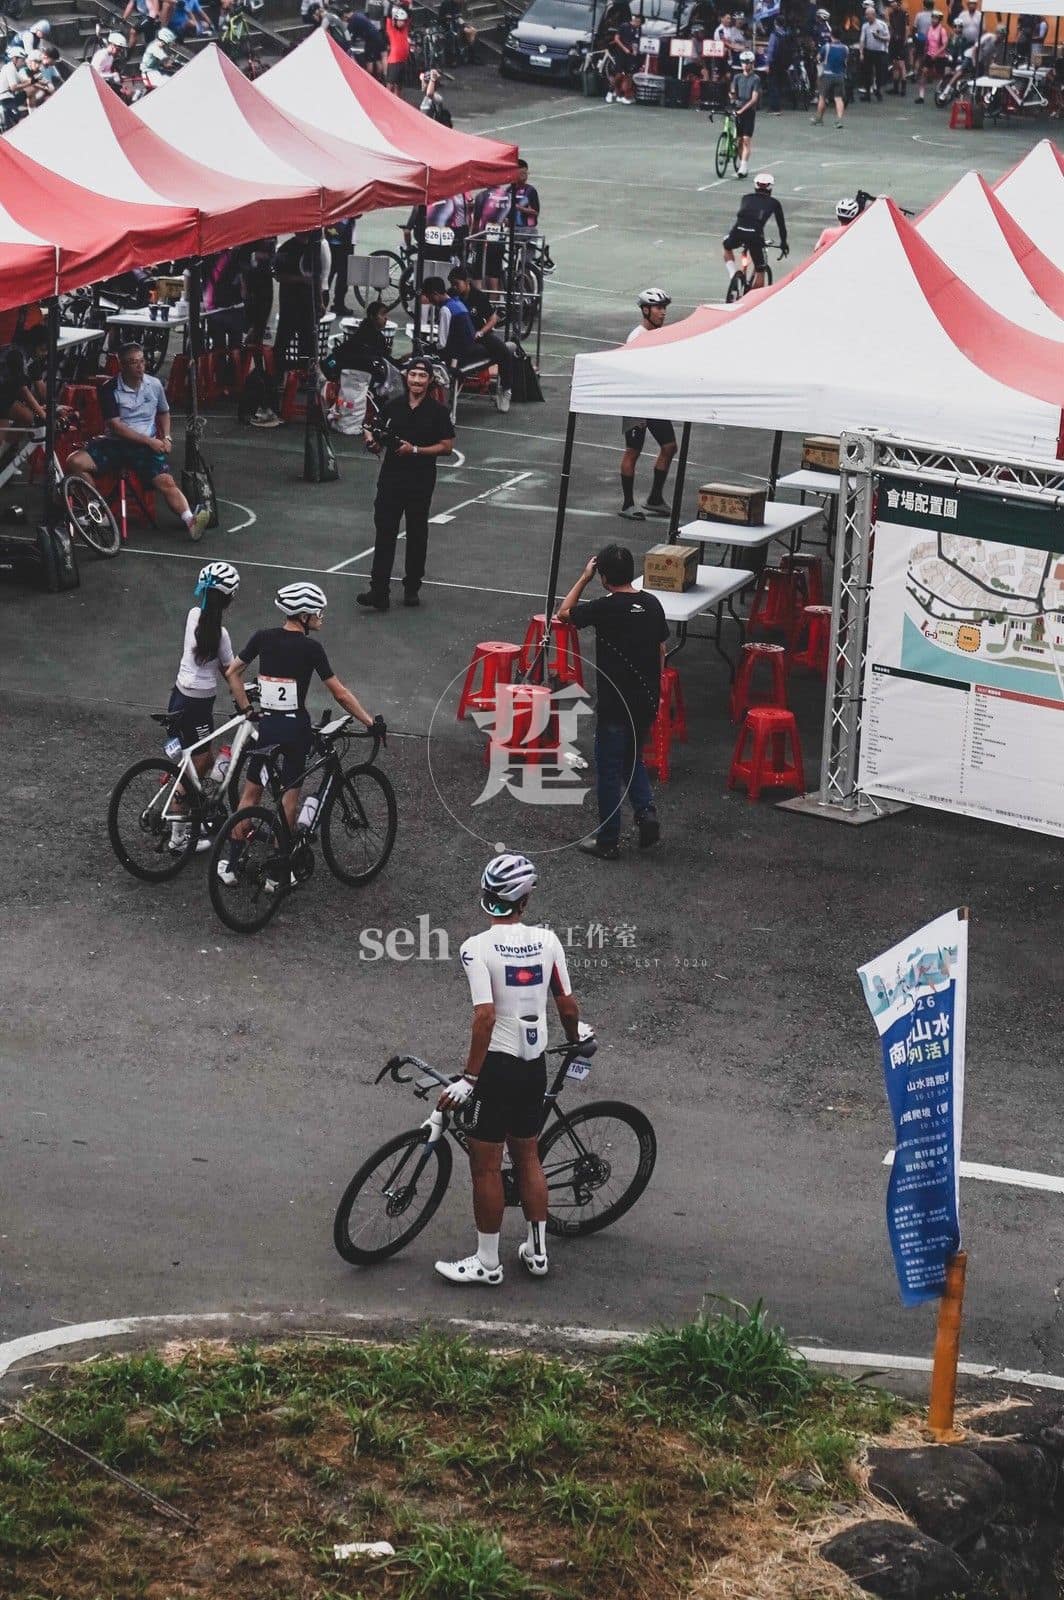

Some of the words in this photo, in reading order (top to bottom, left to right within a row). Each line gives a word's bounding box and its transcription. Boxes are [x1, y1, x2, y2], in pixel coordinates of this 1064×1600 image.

[887, 488, 958, 519] 會場配置圖
[278, 687, 287, 701] 2
[494, 942, 544, 954] EDWONDER
